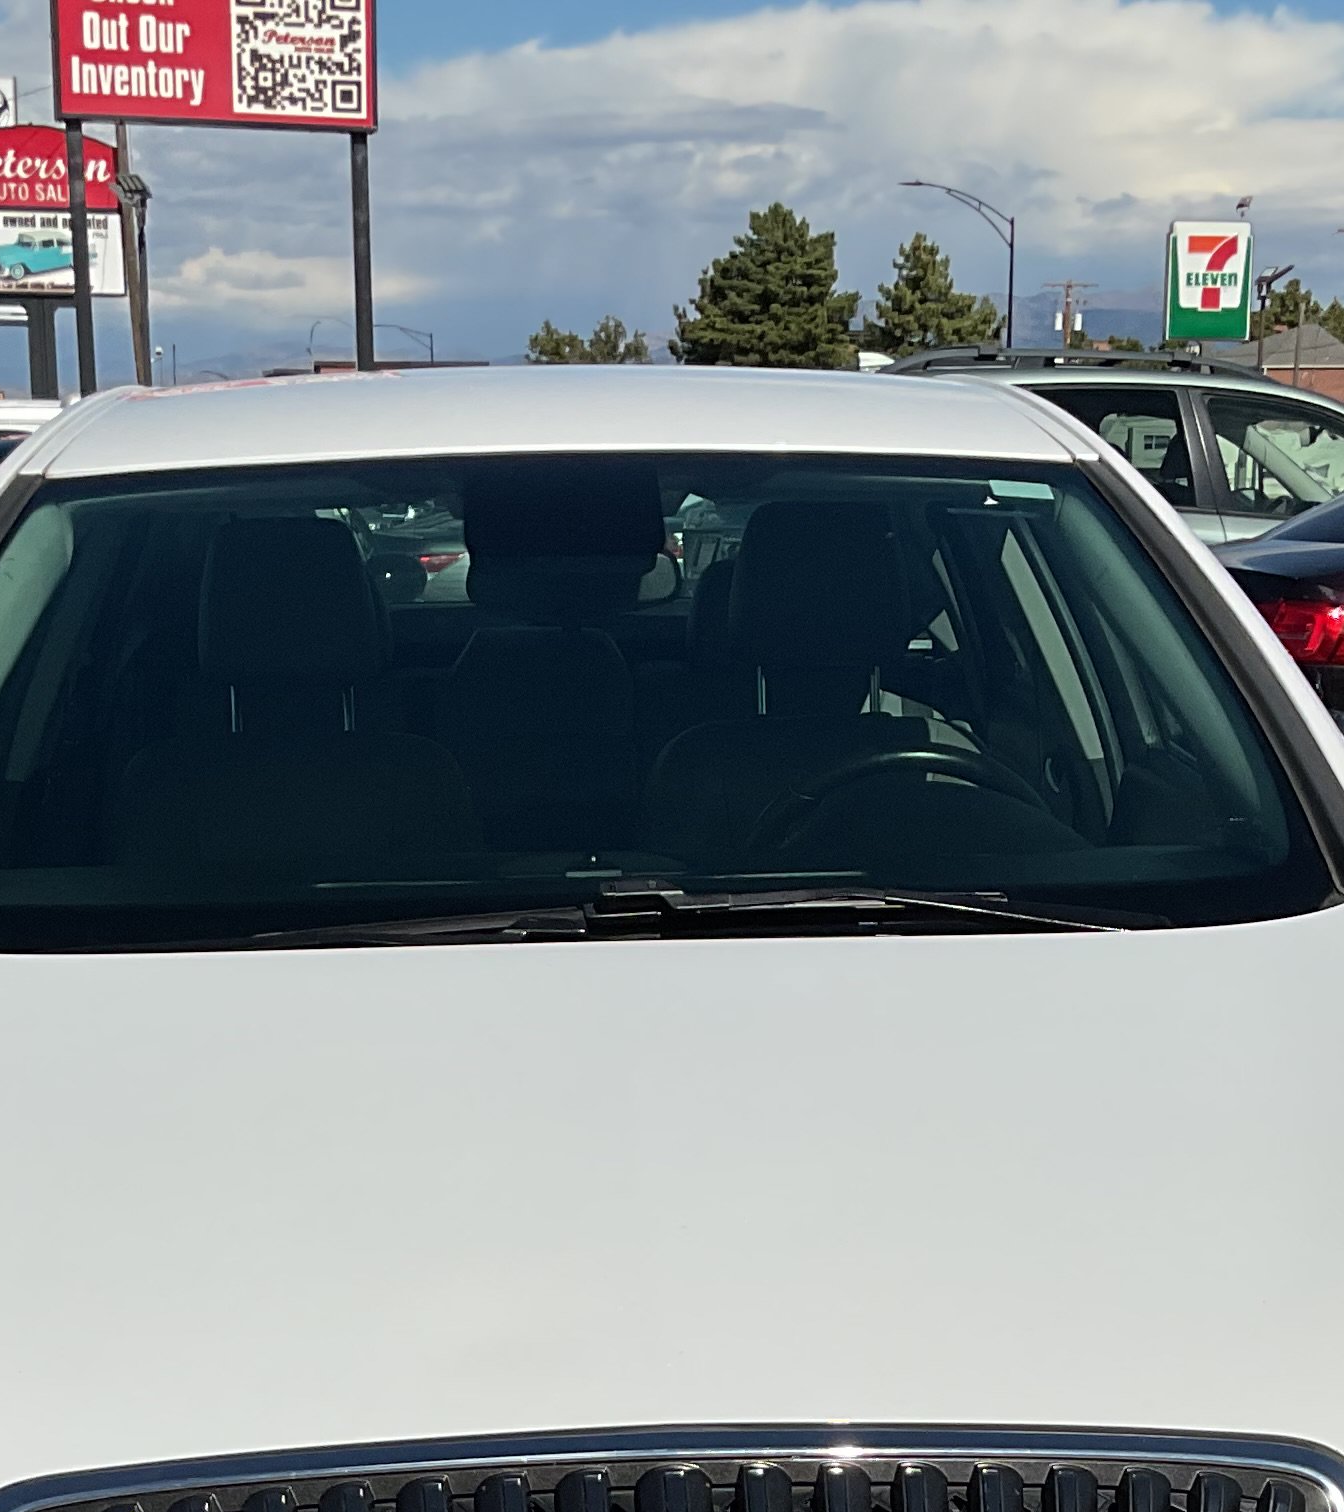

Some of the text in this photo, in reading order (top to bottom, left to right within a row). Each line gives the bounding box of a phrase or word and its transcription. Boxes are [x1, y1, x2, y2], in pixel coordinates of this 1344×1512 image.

[82, 11, 190, 53] Out Our
[262, 29, 336, 47] Peterson
[71, 55, 205, 106] Inventory
[35, 183, 68, 202] SAL
[3, 215, 36, 228] owned
[40, 215, 58, 229] and
[1187, 235, 1239, 309] 7
